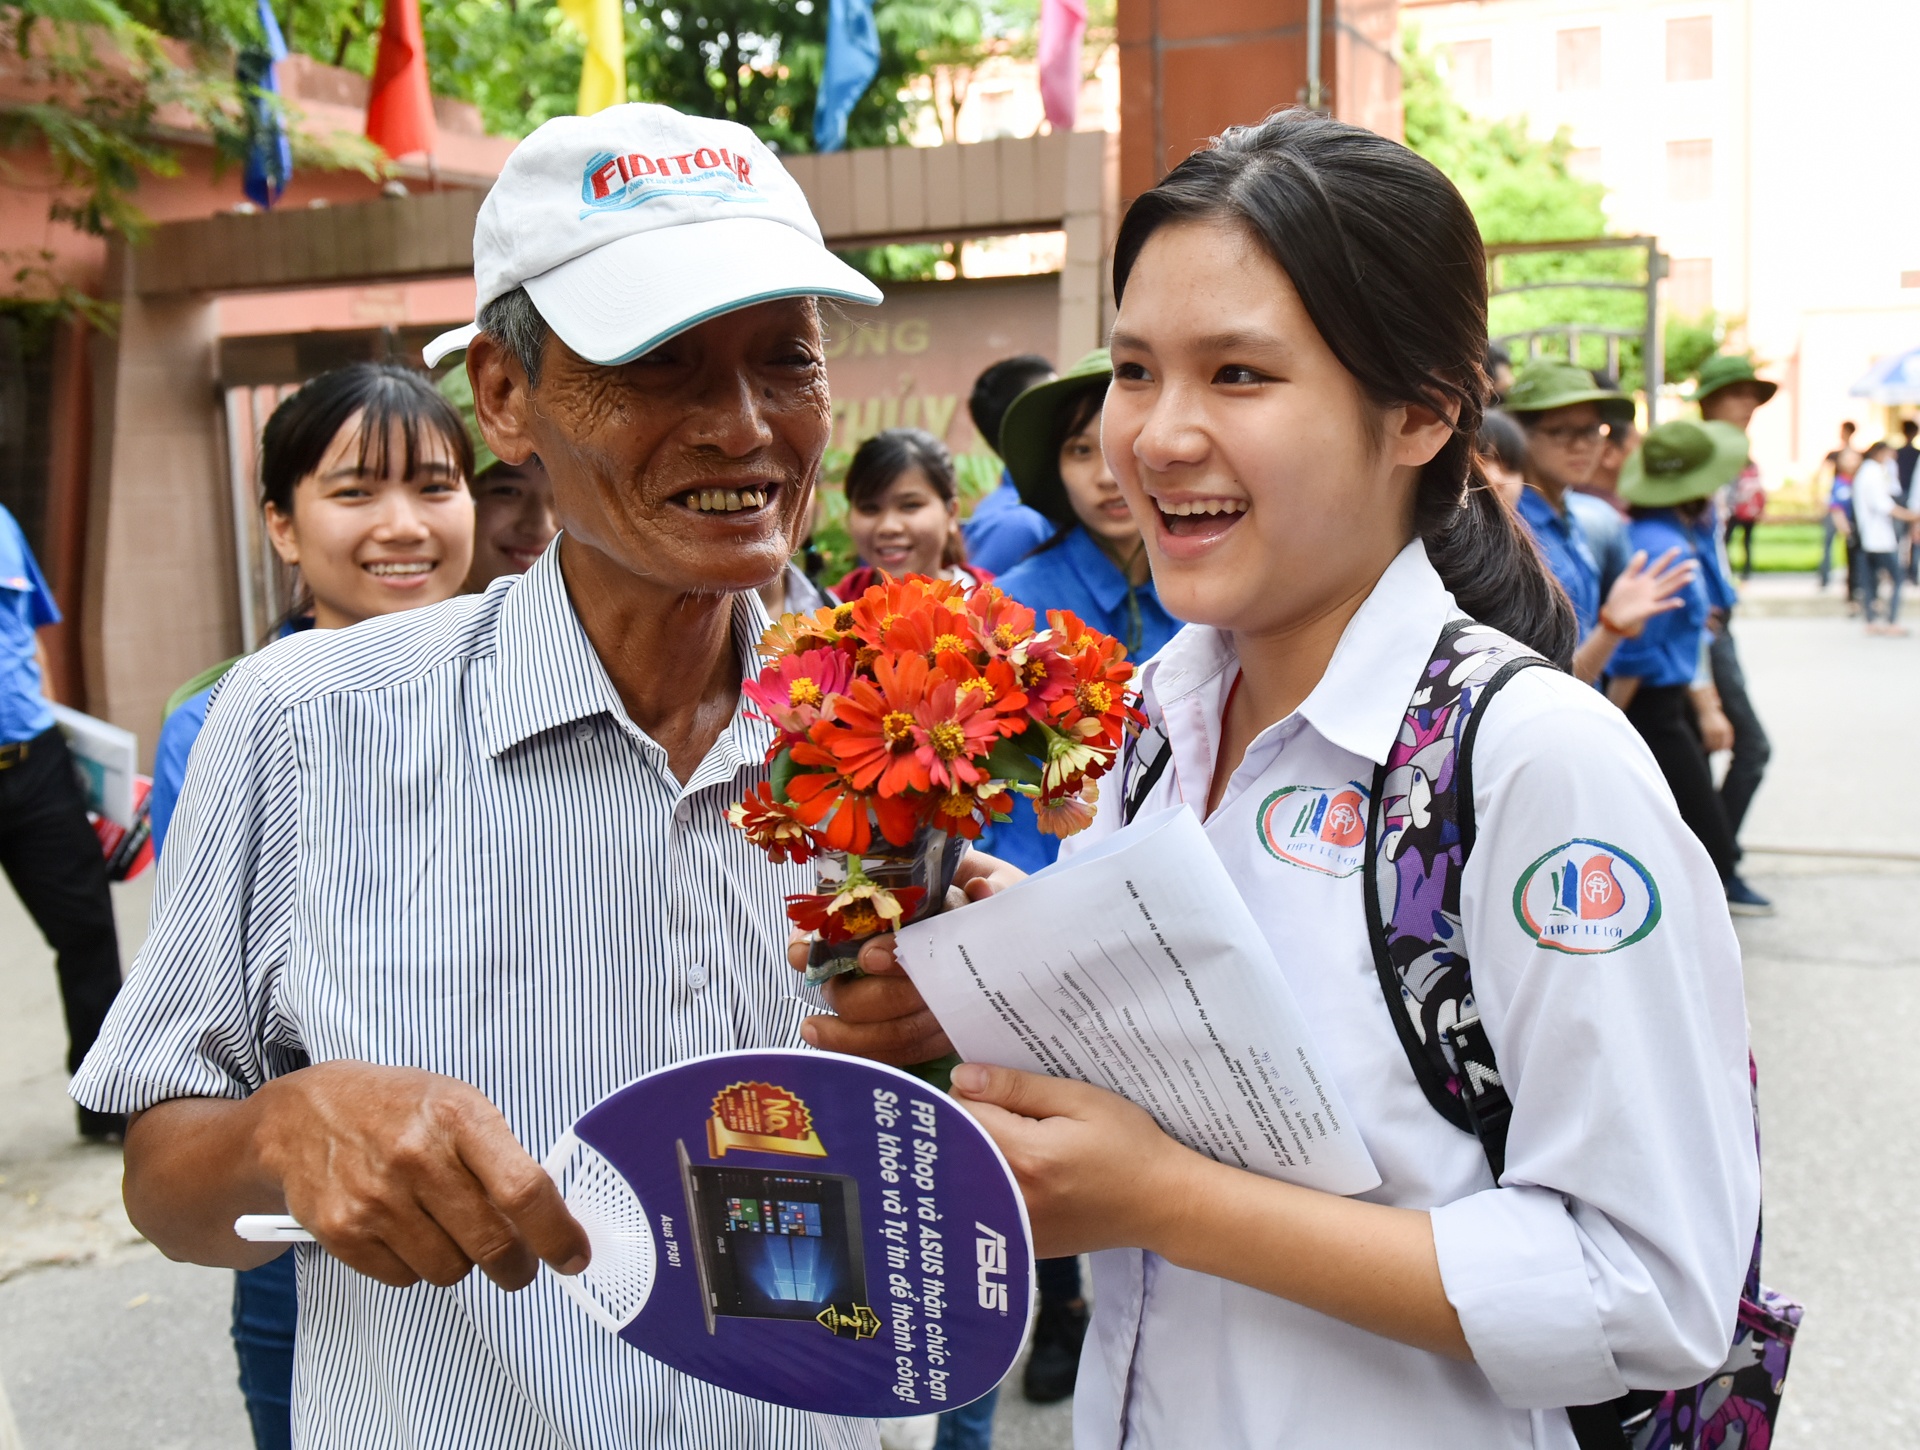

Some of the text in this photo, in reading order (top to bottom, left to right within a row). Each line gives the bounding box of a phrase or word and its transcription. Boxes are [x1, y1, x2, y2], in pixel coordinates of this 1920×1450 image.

[590, 148, 753, 200] FIDITOUR
[1125, 880, 1139, 899] Write
[1154, 932, 1166, 945] how
[957, 944, 978, 975] sentence
[1163, 946, 1181, 968] knowing
[975, 977, 985, 988] the
[1184, 978, 1201, 1005] benefits
[988, 998, 1003, 1012] same
[1000, 1013, 1010, 1021] the
[1006, 1007, 1024, 1023] answer
[1198, 1008, 1207, 1020] the
[1008, 1021, 1023, 1036] means
[1021, 1024, 1035, 1034] your
[1203, 1022, 1218, 1041] about
[1024, 1041, 1037, 1051] that
[1036, 1040, 1058, 1063] sentences
[1296, 1046, 1305, 1061] lives
[1034, 1052, 1045, 1062] way
[1214, 1042, 1236, 1073] paragraph
[1074, 1066, 1083, 1075] the
[1236, 1080, 1247, 1096] write
[1243, 1075, 1258, 1099] answer
[1255, 1098, 1268, 1113] your
[1312, 1112, 1326, 1136] Relaxing
[1263, 1133, 1276, 1149] about
[1267, 1123, 1288, 1152] paragraph
[1283, 1150, 1295, 1165] your
[660, 1214, 682, 1268] Asus TP301
[873, 1088, 921, 1405] Sức khỏe và Tự tin để thành công!
[910, 1099, 951, 1401] FPT Shop và ASUS thân chúc bạn
[975, 1221, 1007, 1312] ASUS
[840, 1314, 862, 1327] 2
